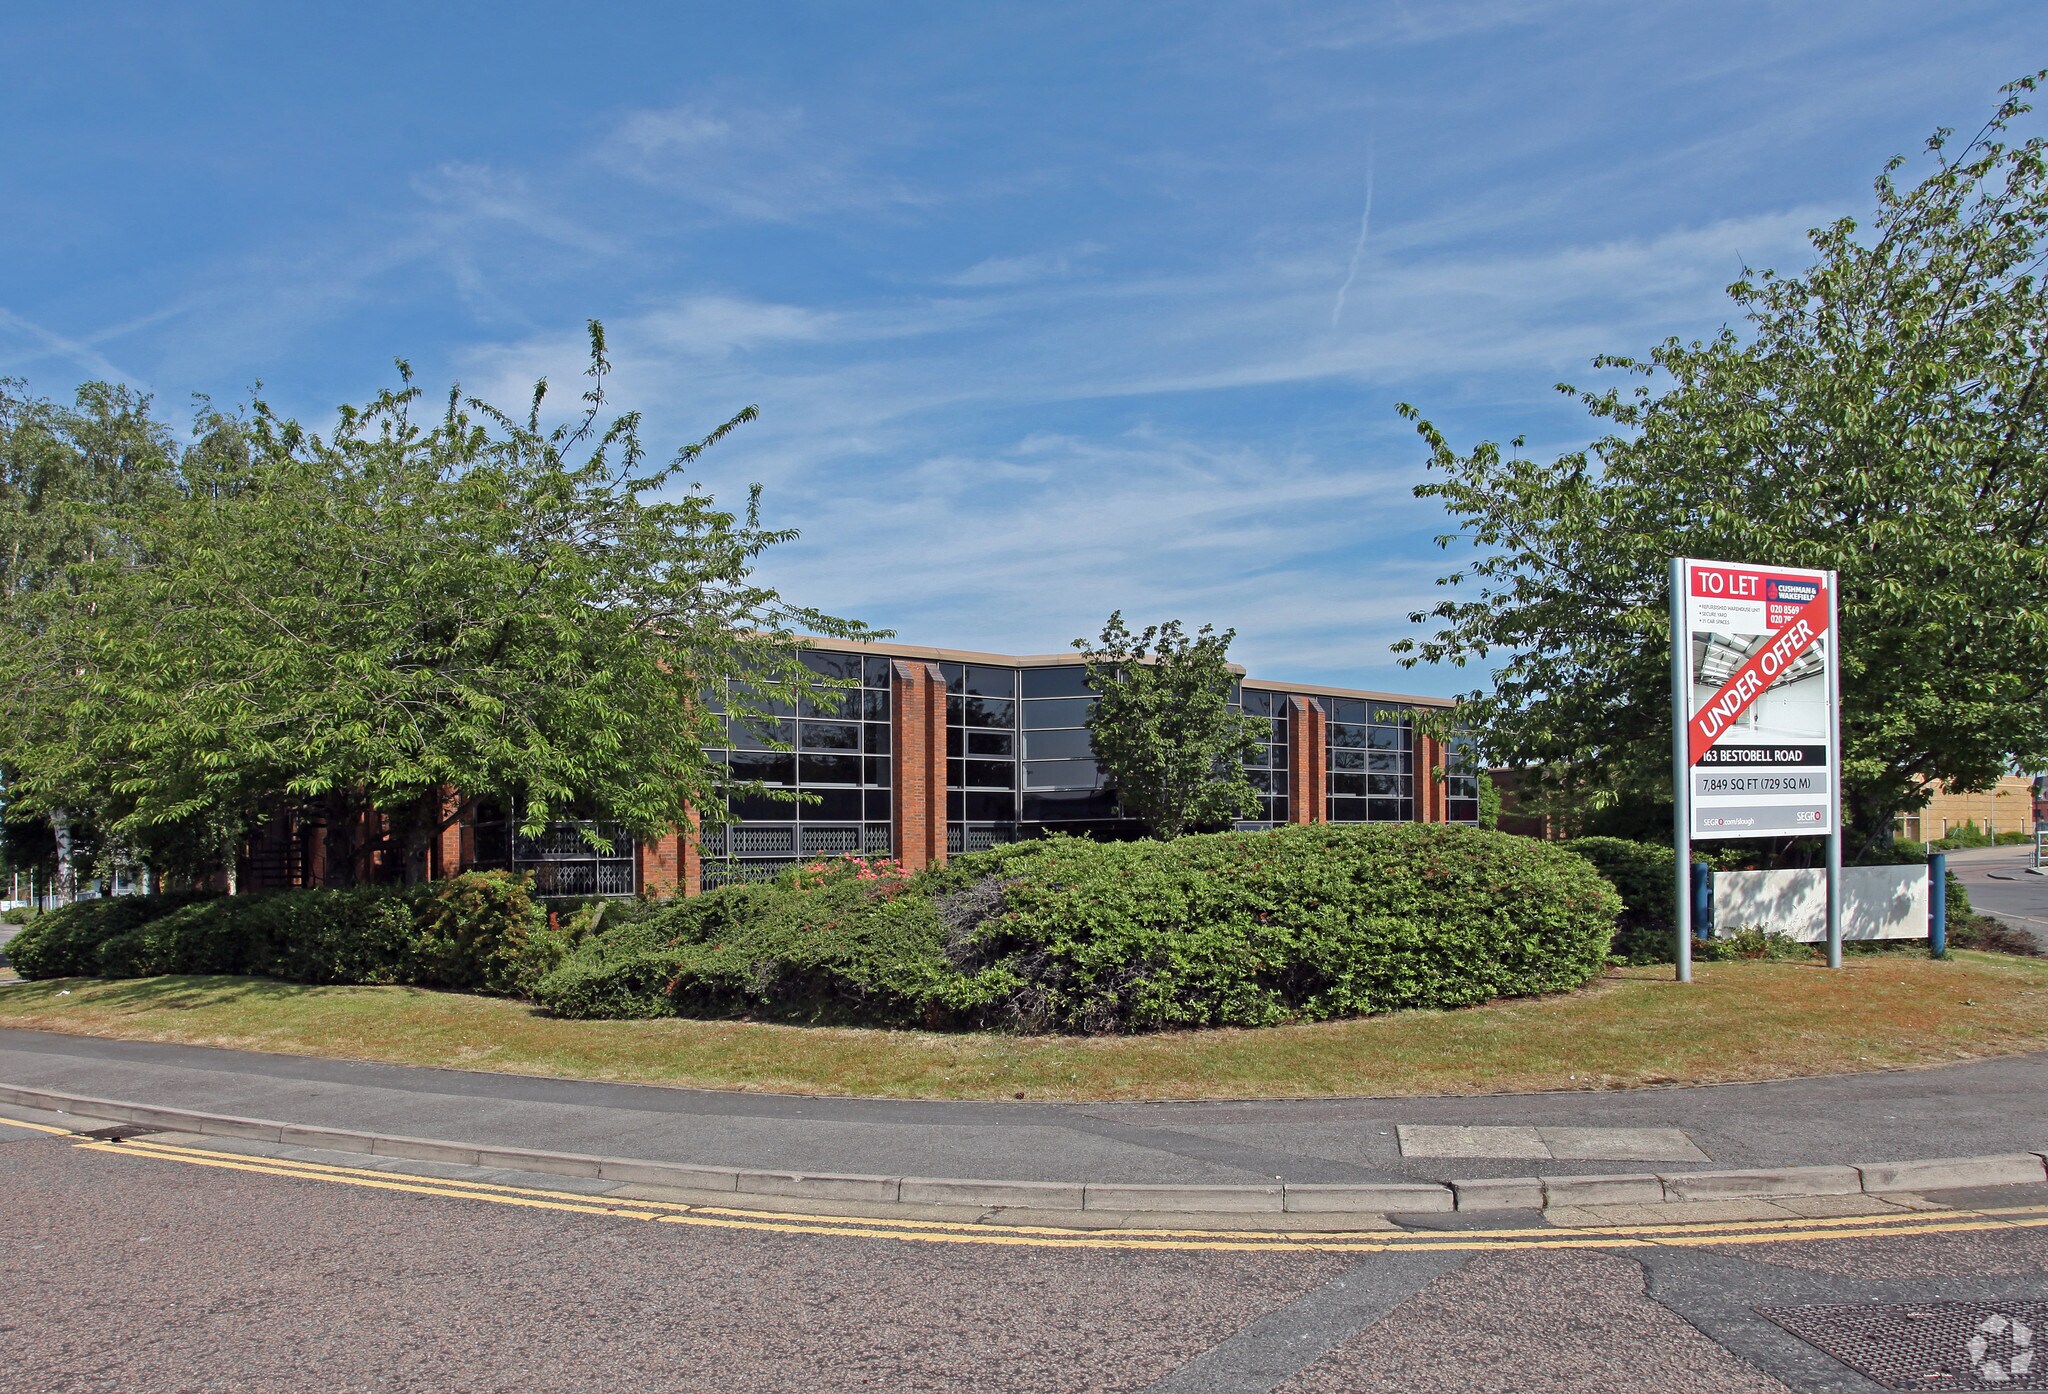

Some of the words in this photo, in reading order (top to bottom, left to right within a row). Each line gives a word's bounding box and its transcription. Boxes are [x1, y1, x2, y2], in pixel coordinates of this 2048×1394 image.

[1698, 571, 1724, 594] TO
[1729, 574, 1759, 596] LET
[1778, 585, 1811, 594] CUSHMAN
[1778, 592, 1815, 600] WAKEFIELD
[1770, 604, 1783, 614] 020
[1783, 605, 1800, 615] 8569
[1770, 614, 1783, 624] 020
[1699, 670, 1763, 737] UNDER
[1761, 619, 1814, 676] OFFER
[1720, 749, 1773, 762] BESTOBELL
[1774, 750, 1803, 762] ROAD
[1703, 779, 1728, 792] 7,849
[1730, 778, 1745, 790] SQ
[1747, 778, 1759, 790] FT
[1760, 778, 1780, 790] (729
[1782, 777, 1797, 789] SQ
[1798, 778, 1811, 789] M)
[1796, 811, 1822, 821] SEGRO
